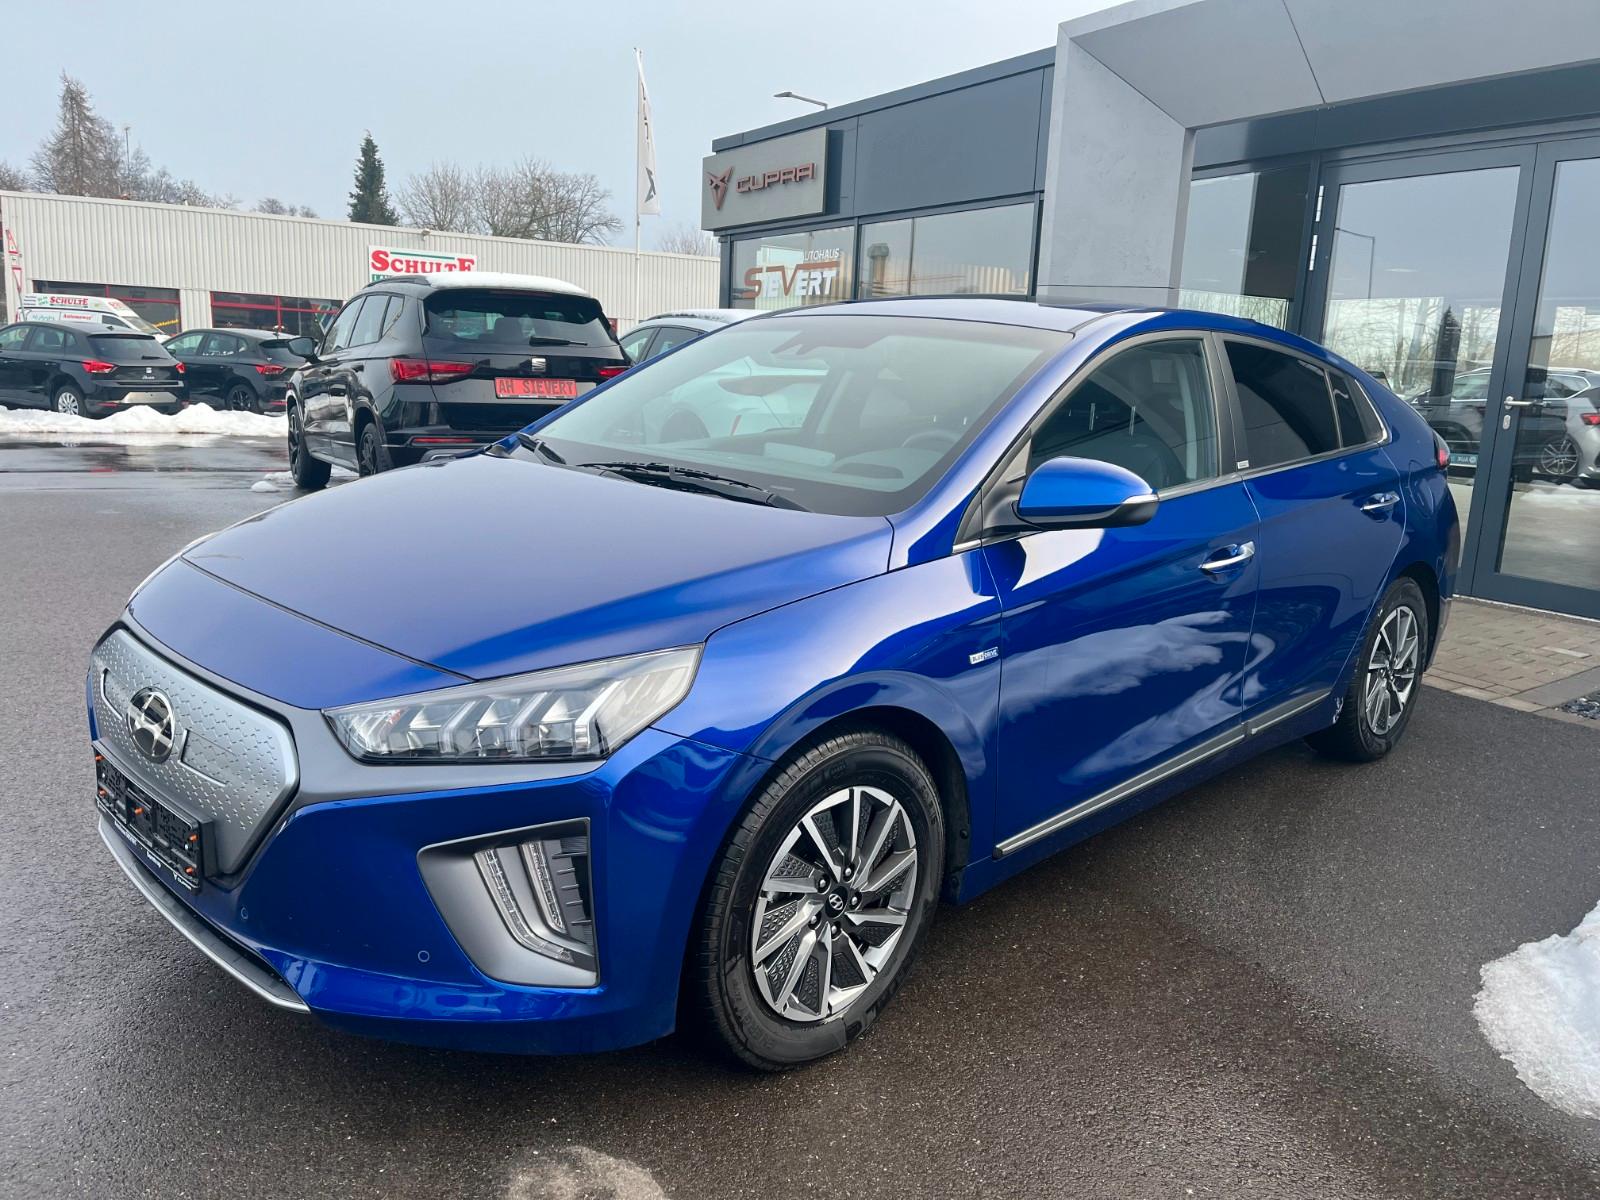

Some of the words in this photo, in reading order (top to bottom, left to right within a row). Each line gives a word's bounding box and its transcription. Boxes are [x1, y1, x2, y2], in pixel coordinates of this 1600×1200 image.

[737, 163, 815, 192] CUPRA
[803, 248, 839, 260] UTOHAUS
[743, 261, 840, 299] SIEVERT
[50, 296, 88, 306] SCHULTE
[500, 380, 514, 394] AH
[523, 380, 574, 395] SIEVERT
